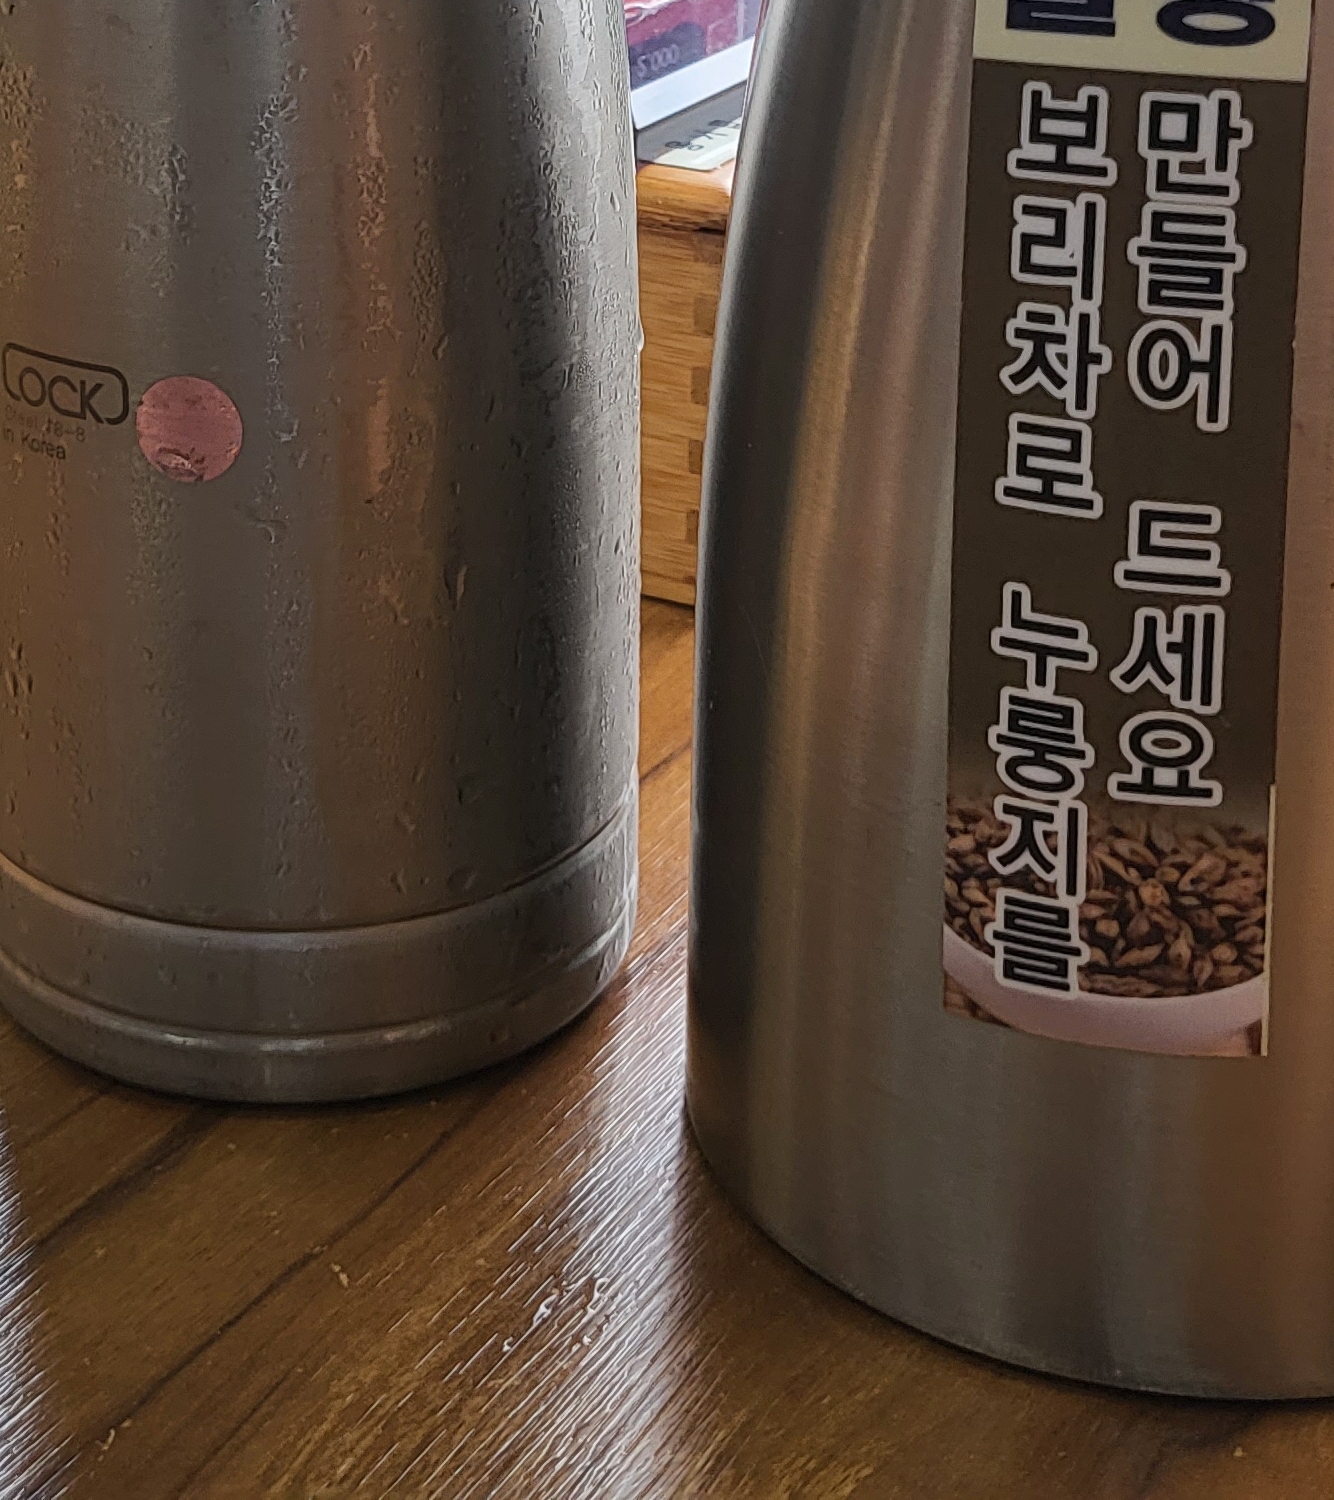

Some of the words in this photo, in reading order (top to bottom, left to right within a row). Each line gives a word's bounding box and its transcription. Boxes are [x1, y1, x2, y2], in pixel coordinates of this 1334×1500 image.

[994, 80, 1118, 519] 보리차로
[1126, 88, 1254, 432] 만들어
[983, 581, 1098, 1001] 누룽지를
[1107, 499, 1231, 808] 드세요
